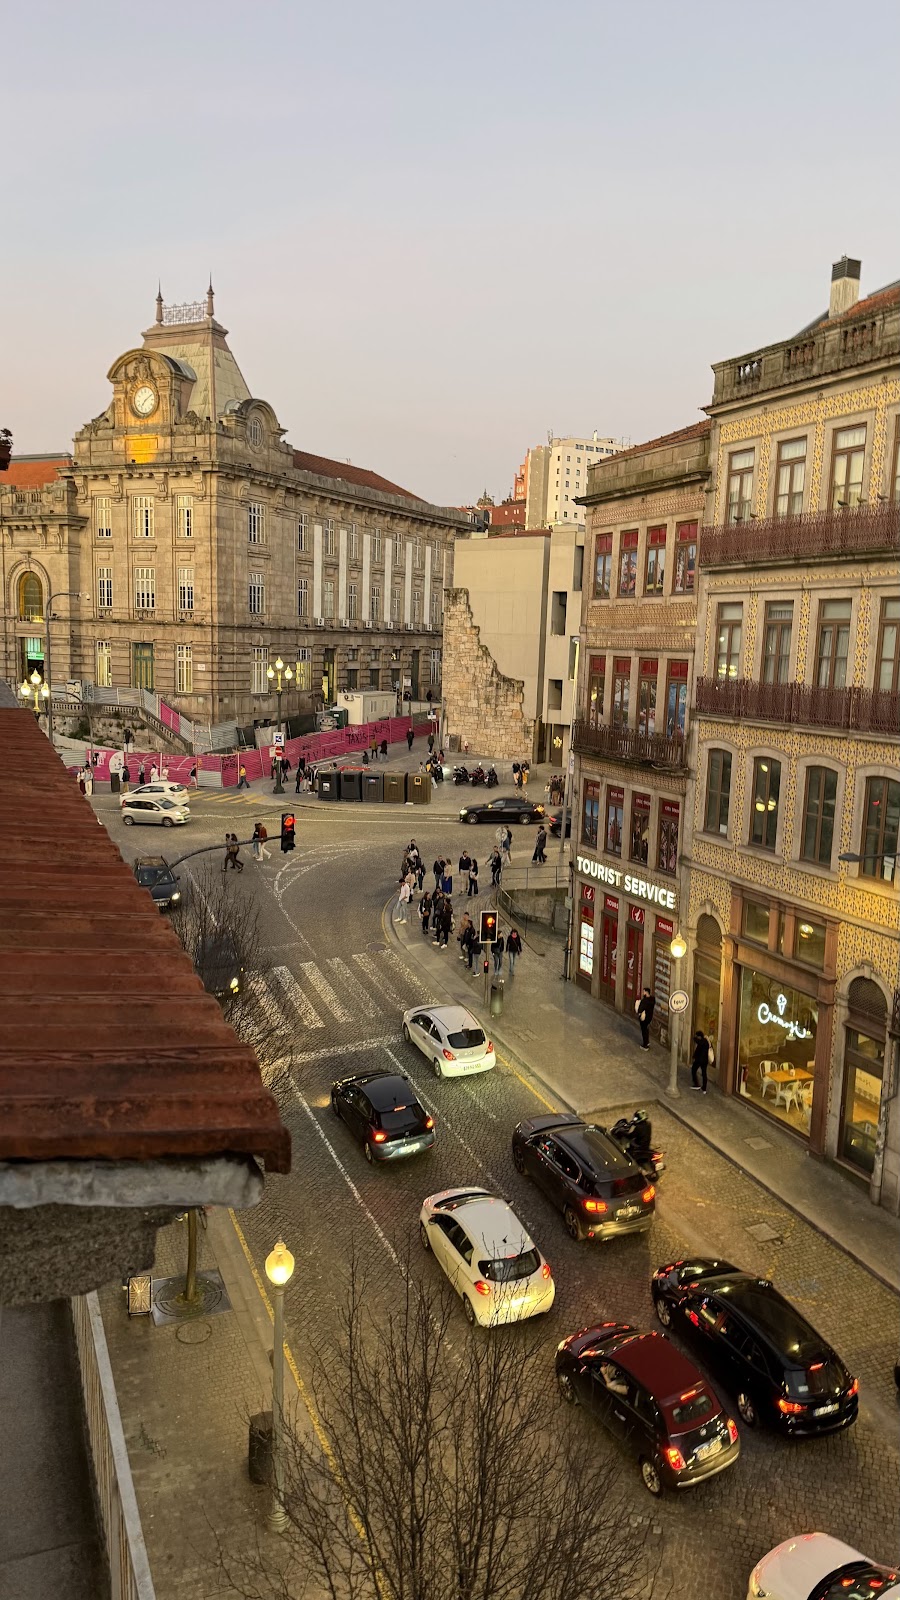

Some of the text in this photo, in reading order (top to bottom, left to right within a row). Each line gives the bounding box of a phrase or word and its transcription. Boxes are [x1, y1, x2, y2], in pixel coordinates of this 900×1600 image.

[345, 732, 367, 745] TAXIS
[576, 855, 676, 910] TOURIST SERVICE
